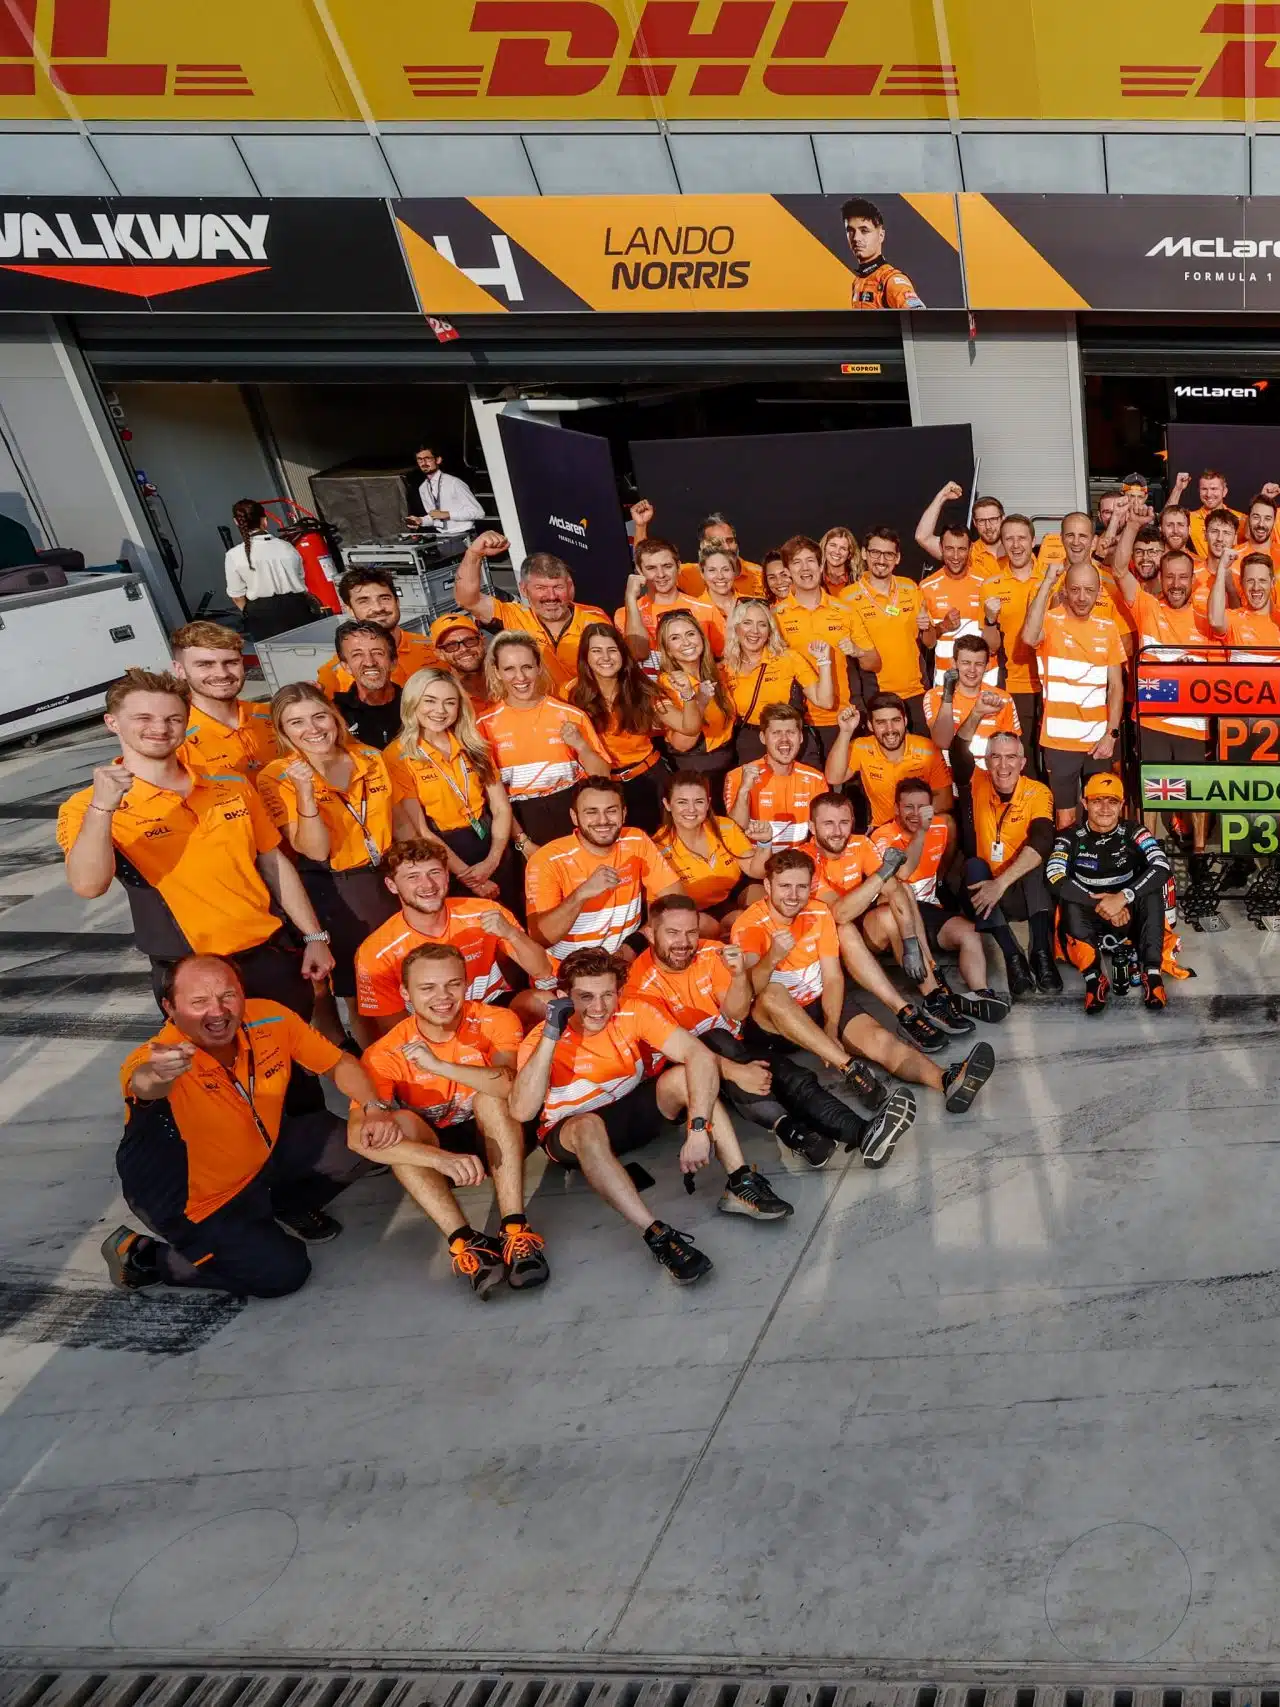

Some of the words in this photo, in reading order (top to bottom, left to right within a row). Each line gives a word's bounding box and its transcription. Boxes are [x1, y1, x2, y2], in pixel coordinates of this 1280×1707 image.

[470, 0, 882, 97] DHL
[604, 225, 735, 257] LANDO
[611, 260, 752, 291] NORRIS
[1184, 271, 1257, 282] FORMULA
[1266, 272, 1273, 282] 1
[851, 365, 879, 373] KOPRON
[1174, 385, 1257, 398] McLaren
[1219, 718, 1280, 761] P2
[421, 773, 439, 781] DELL
[224, 808, 250, 820] OKX
[144, 826, 172, 838] DELL
[1222, 814, 1280, 854] P3
[264, 1060, 285, 1079] OKX
